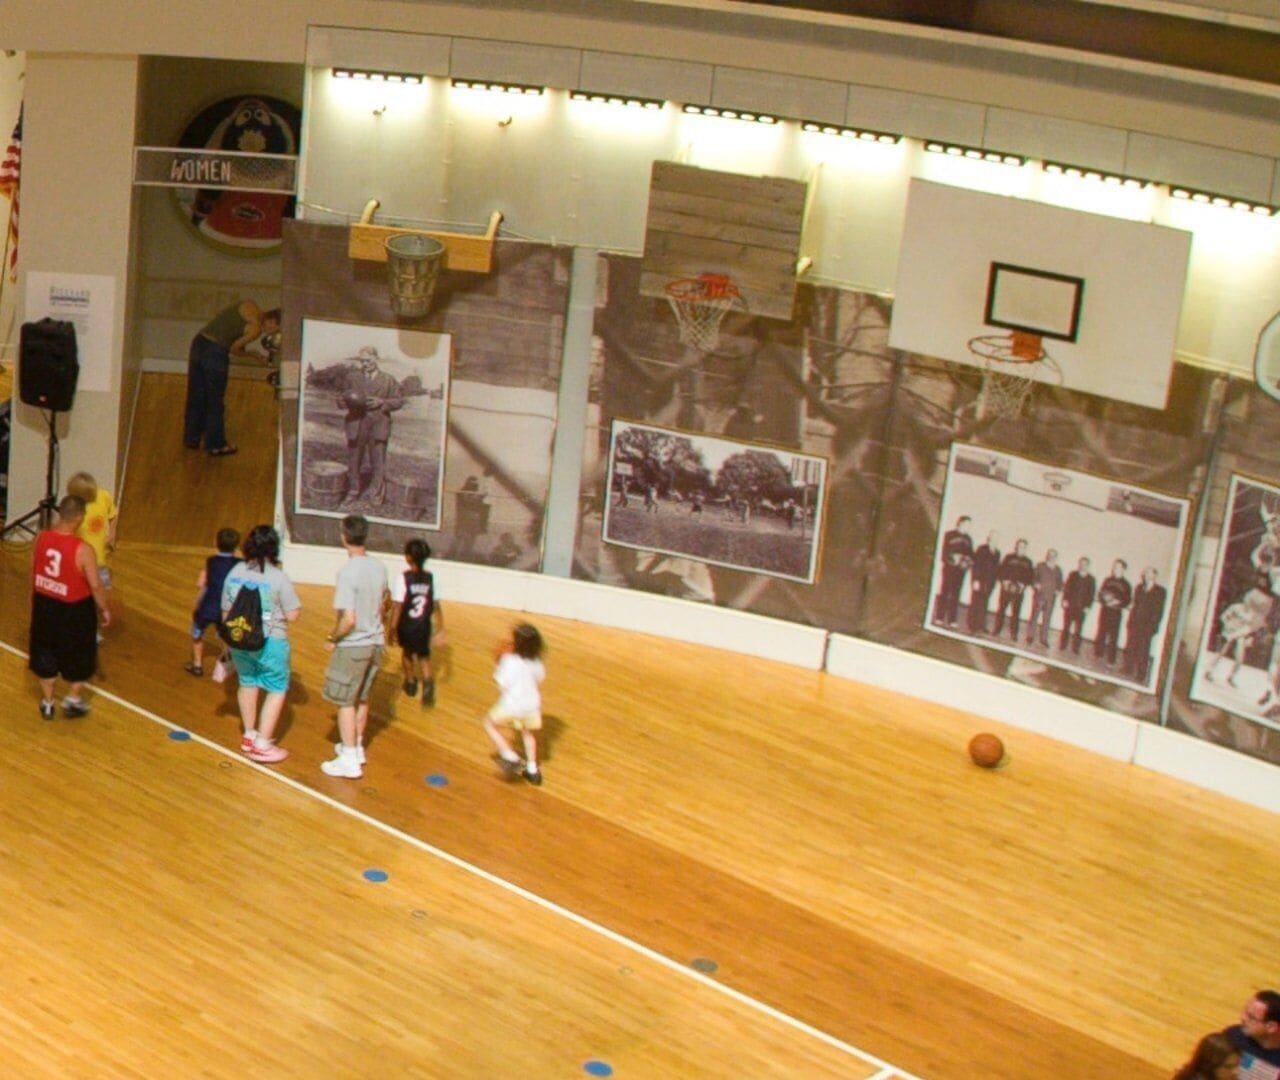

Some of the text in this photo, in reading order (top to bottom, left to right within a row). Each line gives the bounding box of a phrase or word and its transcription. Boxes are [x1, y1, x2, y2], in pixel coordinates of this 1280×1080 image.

[170, 158, 233, 182] WOMEN
[43, 547, 63, 578] 3
[408, 594, 429, 619] 3
